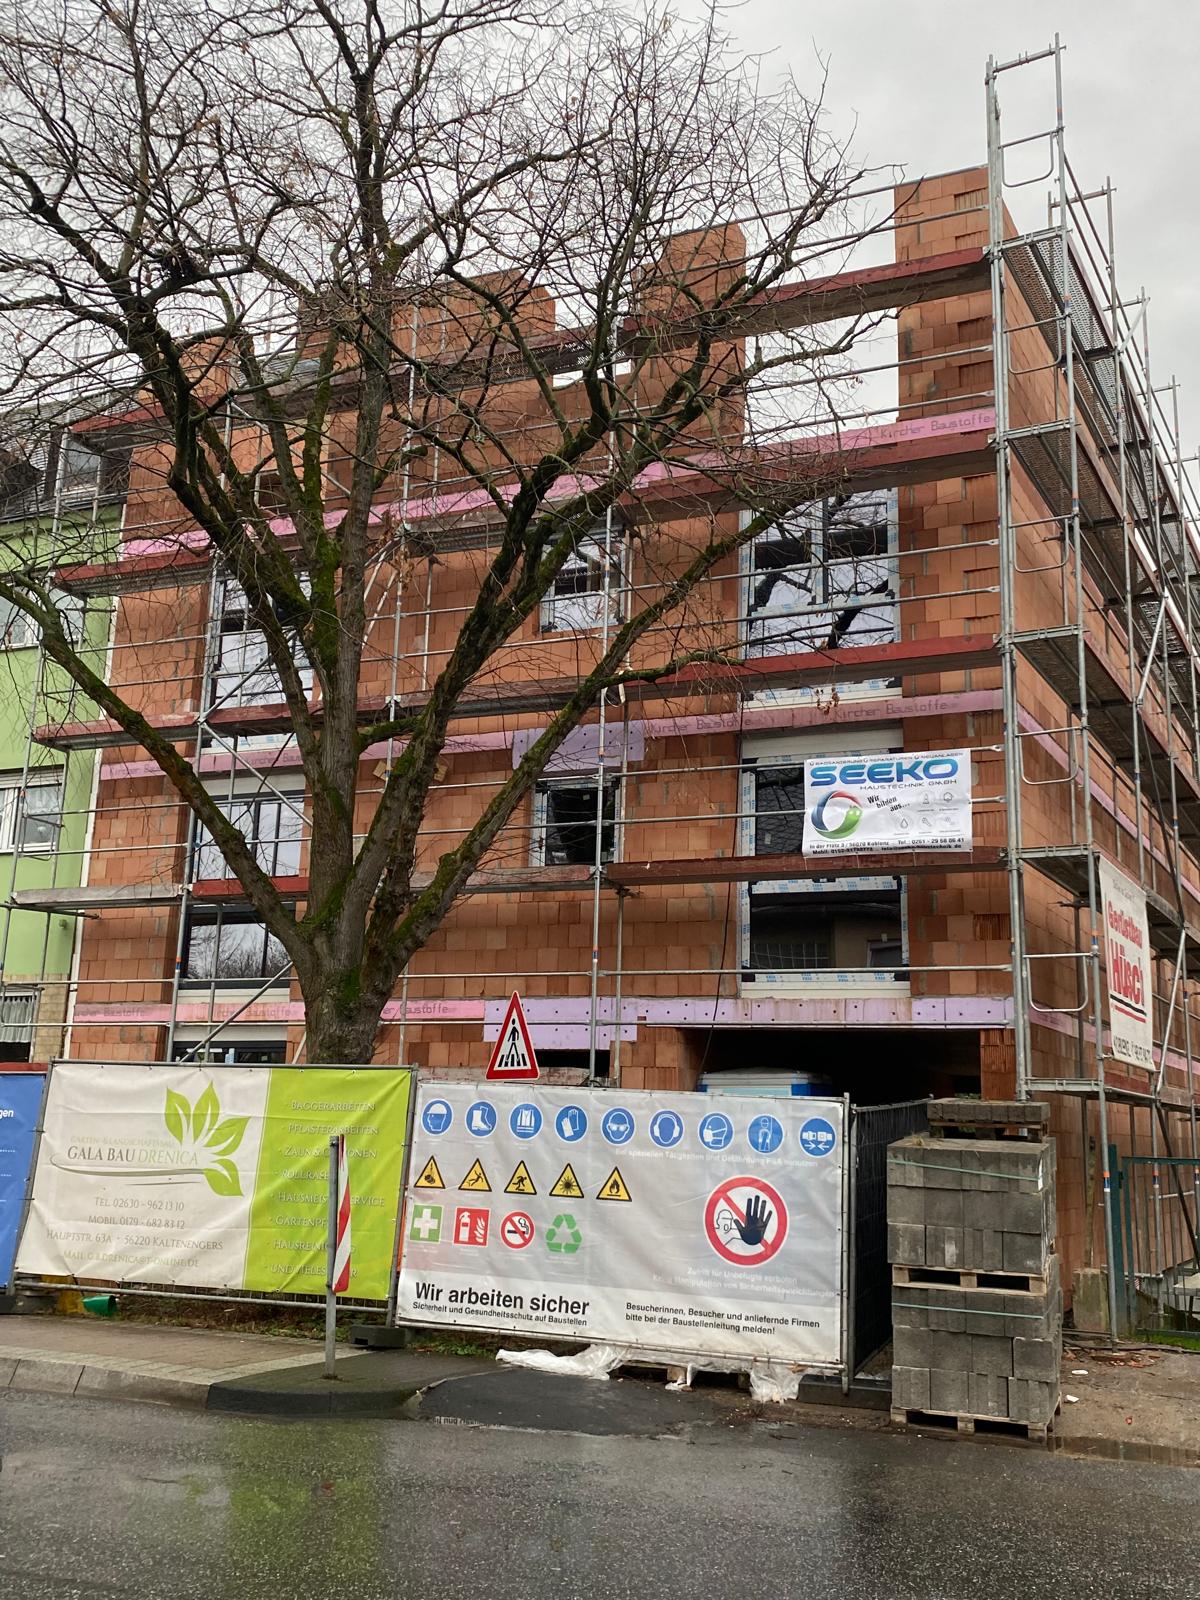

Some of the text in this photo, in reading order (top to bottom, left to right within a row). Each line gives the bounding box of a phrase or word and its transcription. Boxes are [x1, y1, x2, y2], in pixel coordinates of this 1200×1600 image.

[930, 412, 992, 432] Baustoffe
[886, 701, 948, 715] Baustoffe
[810, 758, 959, 787] SEEKO
[859, 782, 925, 791] HAUSTECHNIK
[867, 794, 880, 804] Wir
[876, 796, 898, 809] bilden
[292, 1100, 376, 1112] BAGGERARBEITEN
[288, 1123, 379, 1135] PFLASTERARBEITEN
[67, 1145, 199, 1166] GALA BAU DRENICA
[113, 1198, 139, 1209] 02630
[147, 1200, 163, 1211] 962
[119, 1217, 139, 1227] 0179
[146, 1217, 162, 1228] 682
[163, 1220, 174, 1229] 83
[123, 1234, 151, 1246] 56220
[152, 1236, 224, 1250] KALTENENGERS
[415, 1281, 590, 1316] Wir arbeiten sicher
[413, 1301, 587, 1326] Sicherheit und Gesundheitsschutz auf Baustellen
[626, 1302, 820, 1328] Besucherinnen, Besucher und anliefernde Firmen
[625, 1312, 775, 1334] bitte bei der Baustellenleitung melden!
